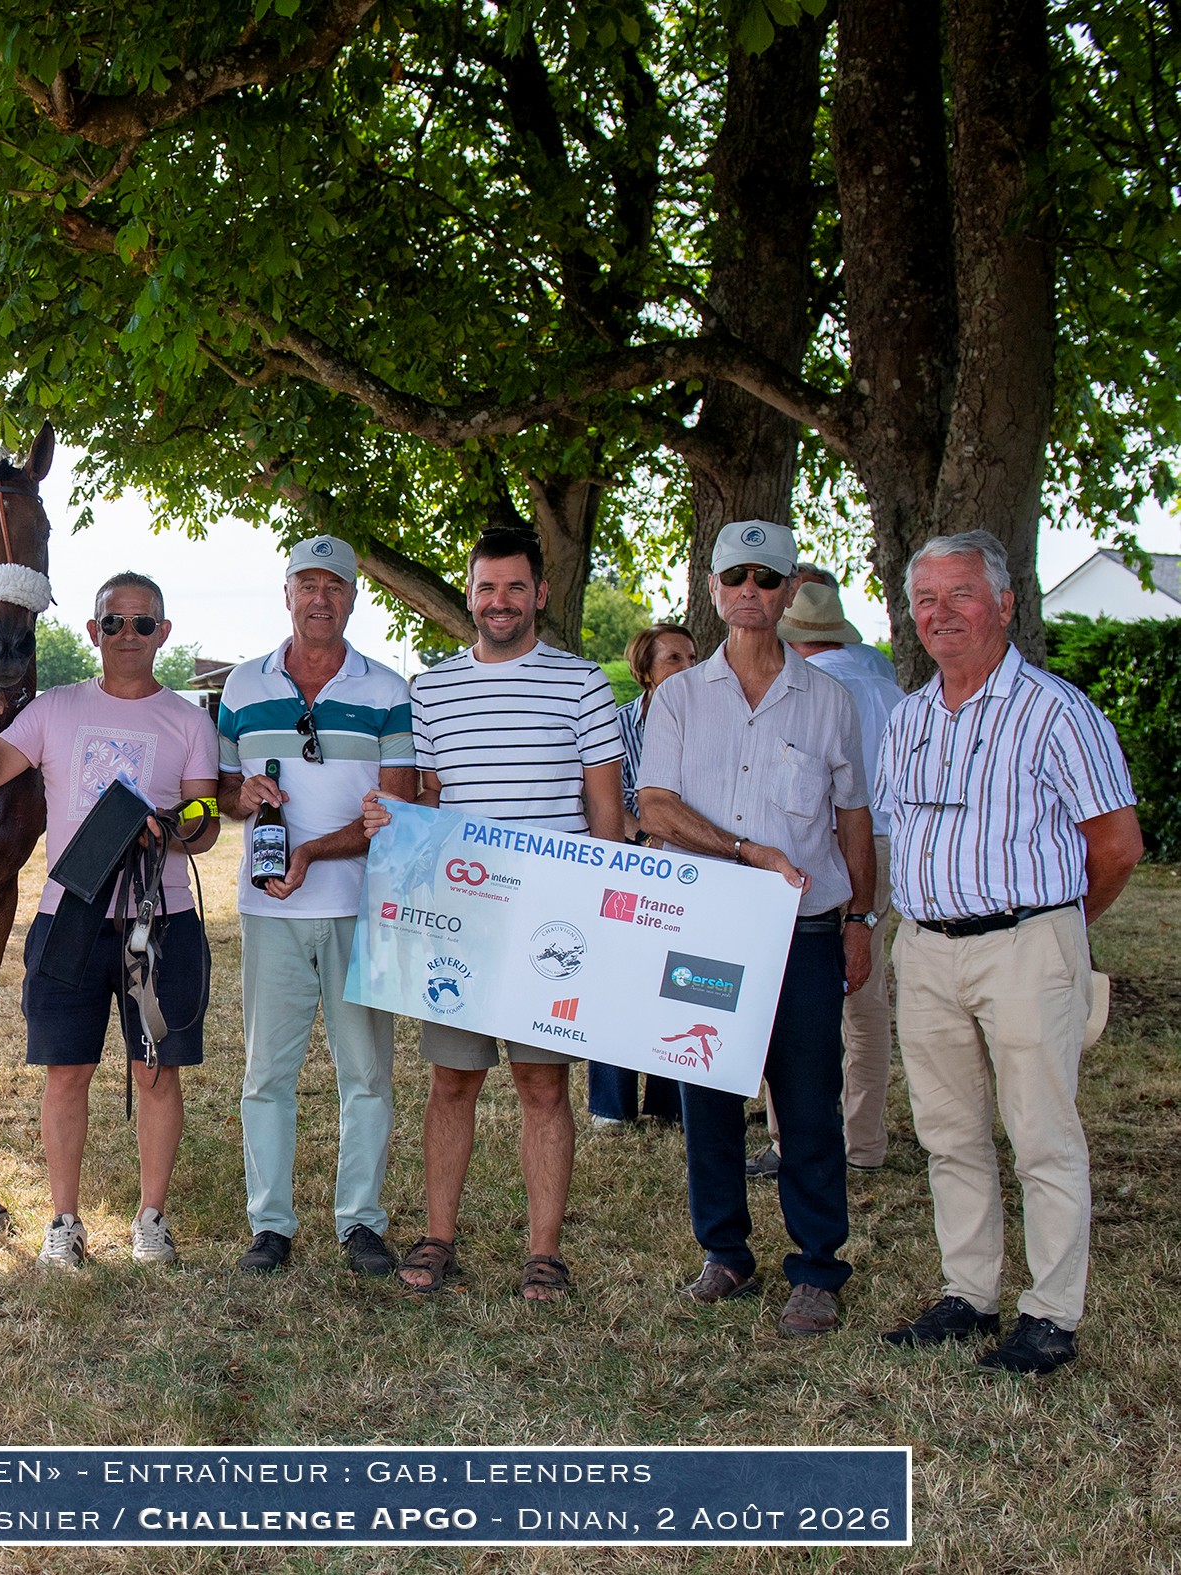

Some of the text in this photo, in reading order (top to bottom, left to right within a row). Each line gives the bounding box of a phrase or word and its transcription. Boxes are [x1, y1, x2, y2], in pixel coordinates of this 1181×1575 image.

[463, 822, 673, 880] PARTENAIRES APGO
[445, 858, 522, 886] GO intérim
[450, 885, 510, 903] www.go-interim.fr
[640, 895, 684, 916] france
[400, 906, 462, 932] FITECO
[636, 913, 681, 932] sire.com
[541, 926, 579, 941] CHAUVIGNY
[427, 956, 473, 979] REVERDY
[532, 1021, 587, 1043] MARKEL
[652, 1047, 667, 1055] Haras
[668, 1052, 697, 1068] LION
